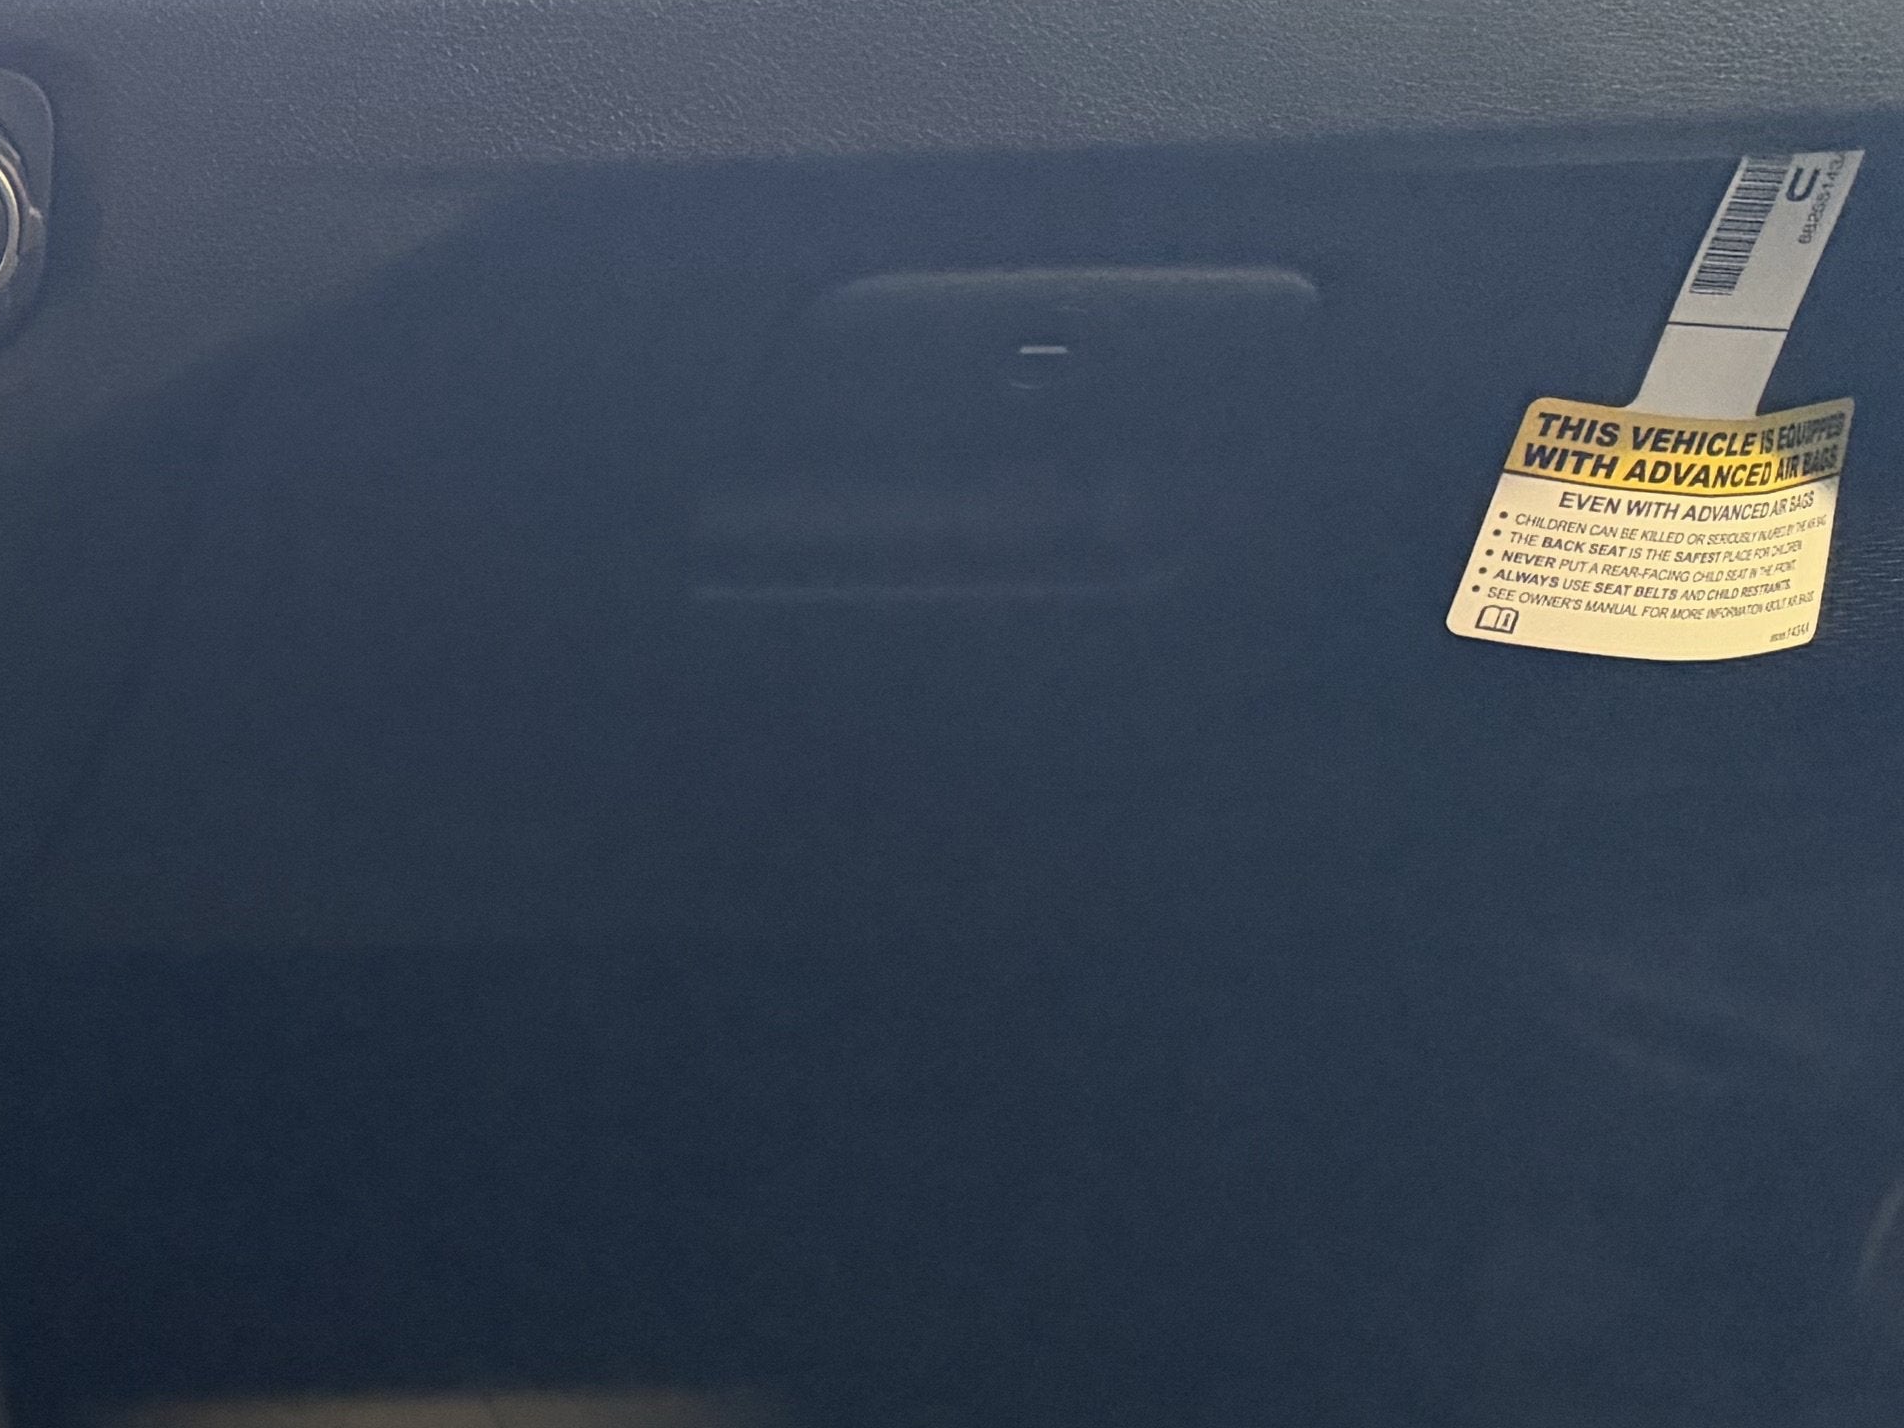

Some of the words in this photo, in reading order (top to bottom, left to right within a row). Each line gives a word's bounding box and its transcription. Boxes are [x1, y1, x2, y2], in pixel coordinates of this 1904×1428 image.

[1786, 167, 1822, 202] U
[1539, 412, 1620, 447] THIS
[1632, 426, 1757, 457] VEHICLE
[1760, 430, 1774, 454] IS
[1524, 443, 1619, 479] WITH
[1623, 459, 1772, 488] ADVANCED
[1775, 455, 1800, 483] AIR
[1559, 491, 1622, 515] EVEN
[1626, 499, 1680, 520] WITH
[1681, 502, 1770, 522] ADVANCED
[1769, 498, 1788, 520] AIR
[1789, 490, 1815, 513] BAGS
[1515, 513, 1587, 534] CHILDREN
[1589, 524, 1618, 538] CAN
[1619, 528, 1639, 540] BE
[1640, 530, 1684, 544] KILLED
[1510, 531, 1539, 547] THE
[1542, 536, 1586, 554] BACK
[1588, 542, 1627, 558] SEAT
[1628, 547, 1642, 559] IS
[1646, 548, 1671, 562] THE
[1674, 551, 1722, 564] SAFEST
[1501, 549, 1556, 568] NEVER
[1559, 558, 1588, 573] PUT
[1588, 562, 1598, 573] A
[1601, 563, 1690, 583] REAR-FACING
[1493, 568, 1559, 588] ALWAYS
[1562, 578, 1591, 592] USE
[1593, 582, 1632, 597] SEAT
[1633, 586, 1678, 600] BELTS
[1487, 586, 1516, 601] SEE
[1518, 591, 1583, 611] OWNER'S
[1584, 599, 1638, 617] MANUAL
[1641, 606, 1671, 619] FOR
